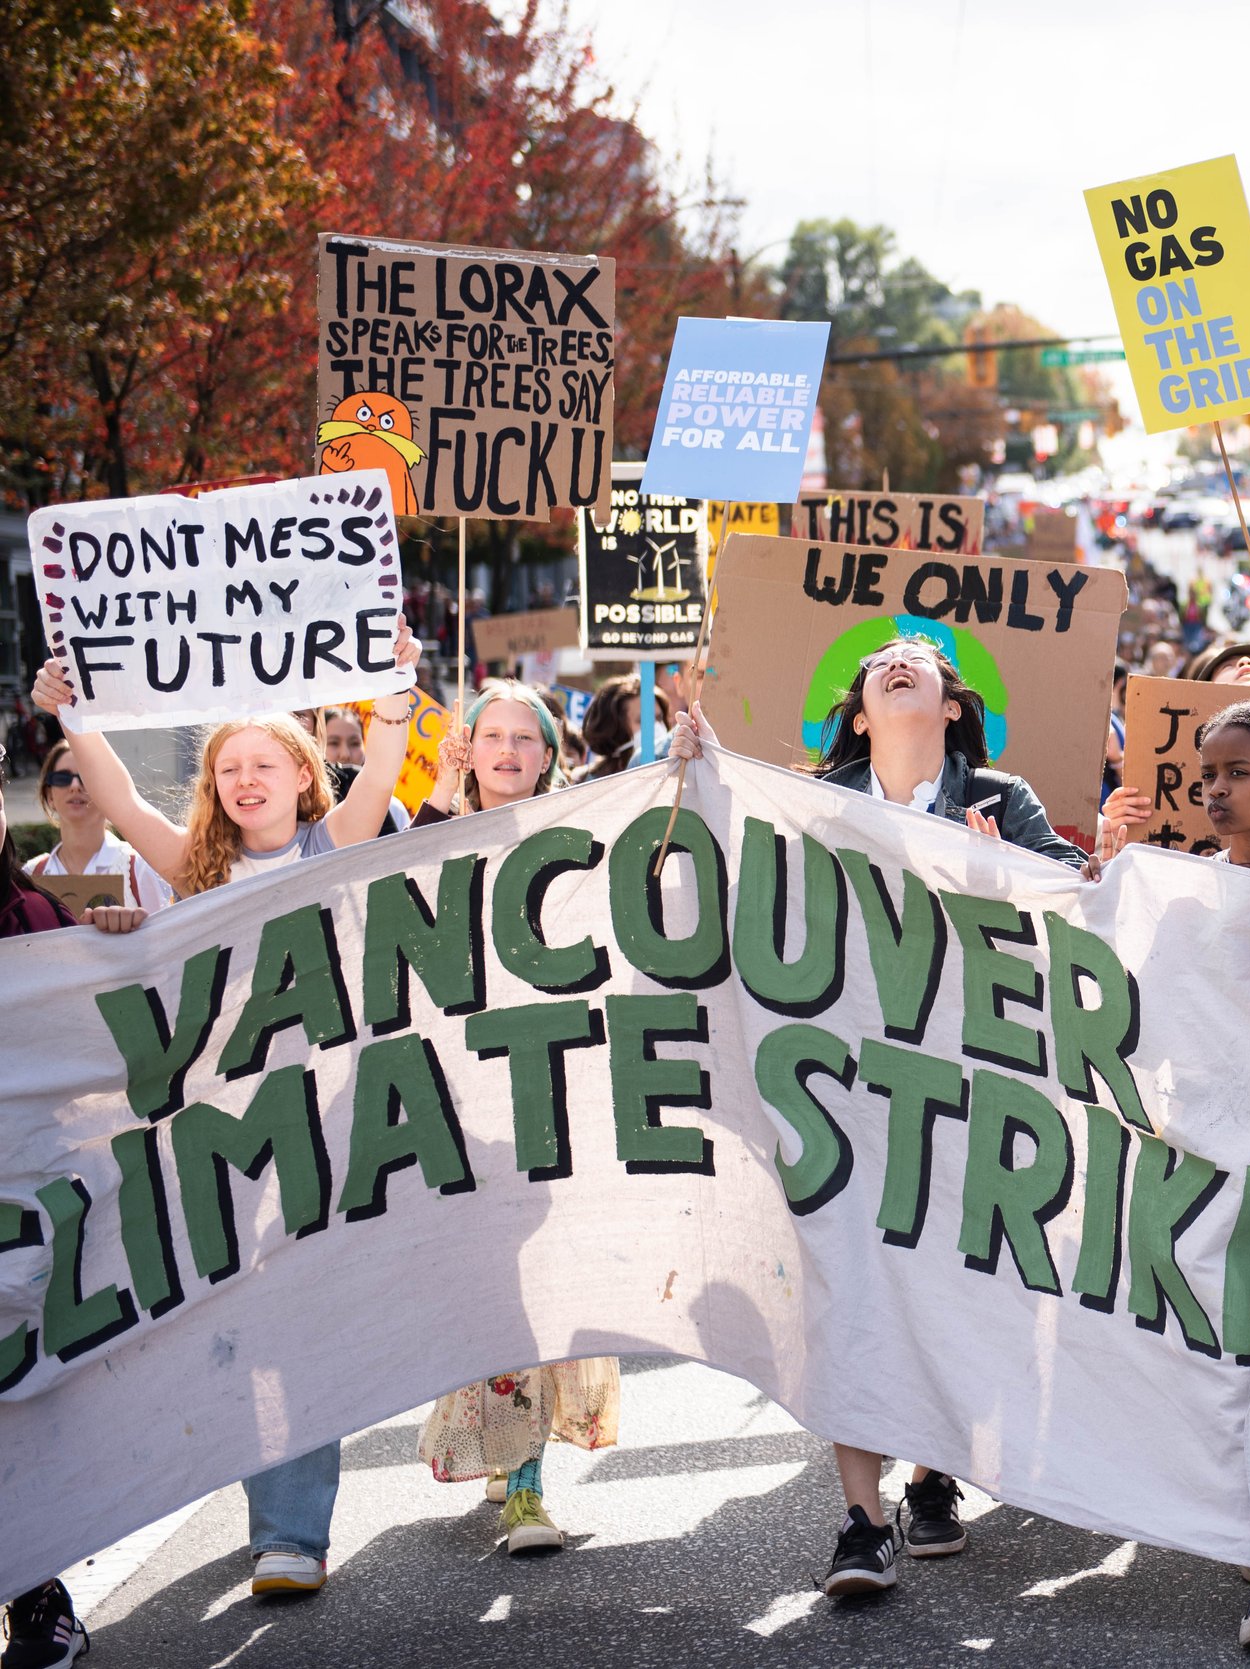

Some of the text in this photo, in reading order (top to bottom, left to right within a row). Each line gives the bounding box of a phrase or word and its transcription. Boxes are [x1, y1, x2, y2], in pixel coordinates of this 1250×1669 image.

[1111, 189, 1178, 239] NO
[1124, 226, 1224, 281] GAS
[326, 242, 610, 328] THE LORAX
[1136, 277, 1202, 326] ON
[446, 323, 505, 360] FOR
[505, 333, 527, 353] THE
[1144, 315, 1241, 370] THE
[331, 357, 612, 424] THE TREES SAY
[671, 383, 810, 407] RELIABLE
[675, 369, 811, 388] AFFORDABLE,
[661, 427, 800, 453] FOR ALL
[666, 402, 805, 430] POWER
[423, 407, 605, 516] FUCK U
[611, 490, 687, 506] NOTHER
[69, 516, 376, 582] DON'T MESS
[602, 536, 617, 550] IS
[802, 498, 967, 551] THIS IS
[70, 579, 299, 629] WITH MY
[595, 604, 701, 623] POSSIBLE
[803, 548, 1089, 632] WE ONLY
[70, 607, 397, 700] FUTURE
[602, 631, 694, 644] GO BEYOND GAS
[96, 806, 1154, 1133] VANCOUVER
